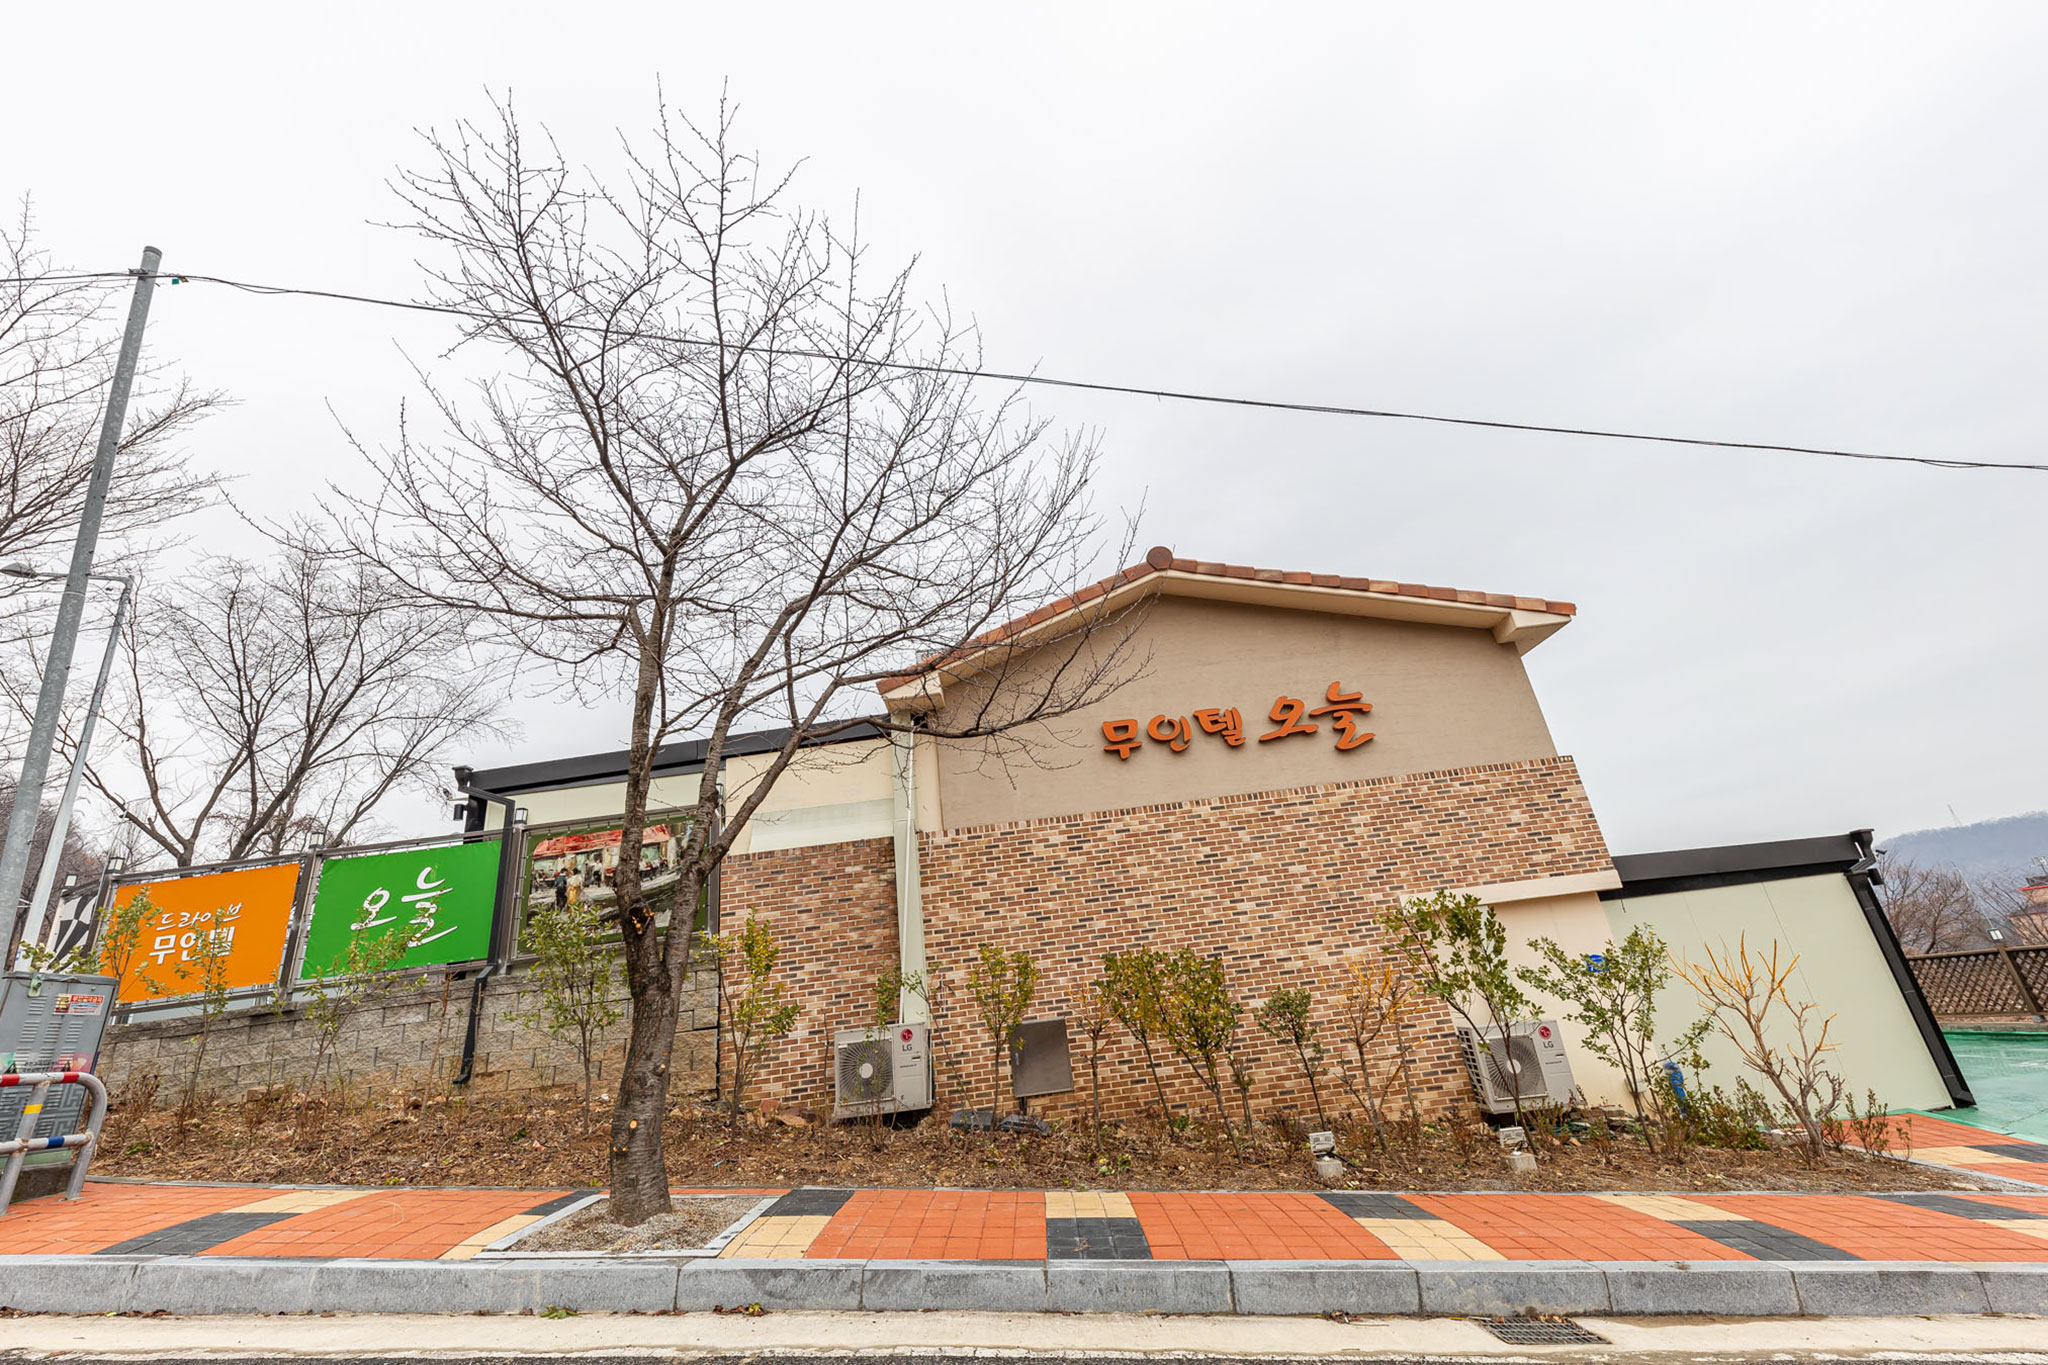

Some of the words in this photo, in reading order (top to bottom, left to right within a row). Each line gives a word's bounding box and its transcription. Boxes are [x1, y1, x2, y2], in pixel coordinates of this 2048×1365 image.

[1102, 706, 1246, 760] 무인텔
[1258, 681, 1376, 751] 오늘
[350, 866, 458, 948] 오늘
[902, 1044, 913, 1052] LG
[1542, 1041, 1554, 1049] LG
